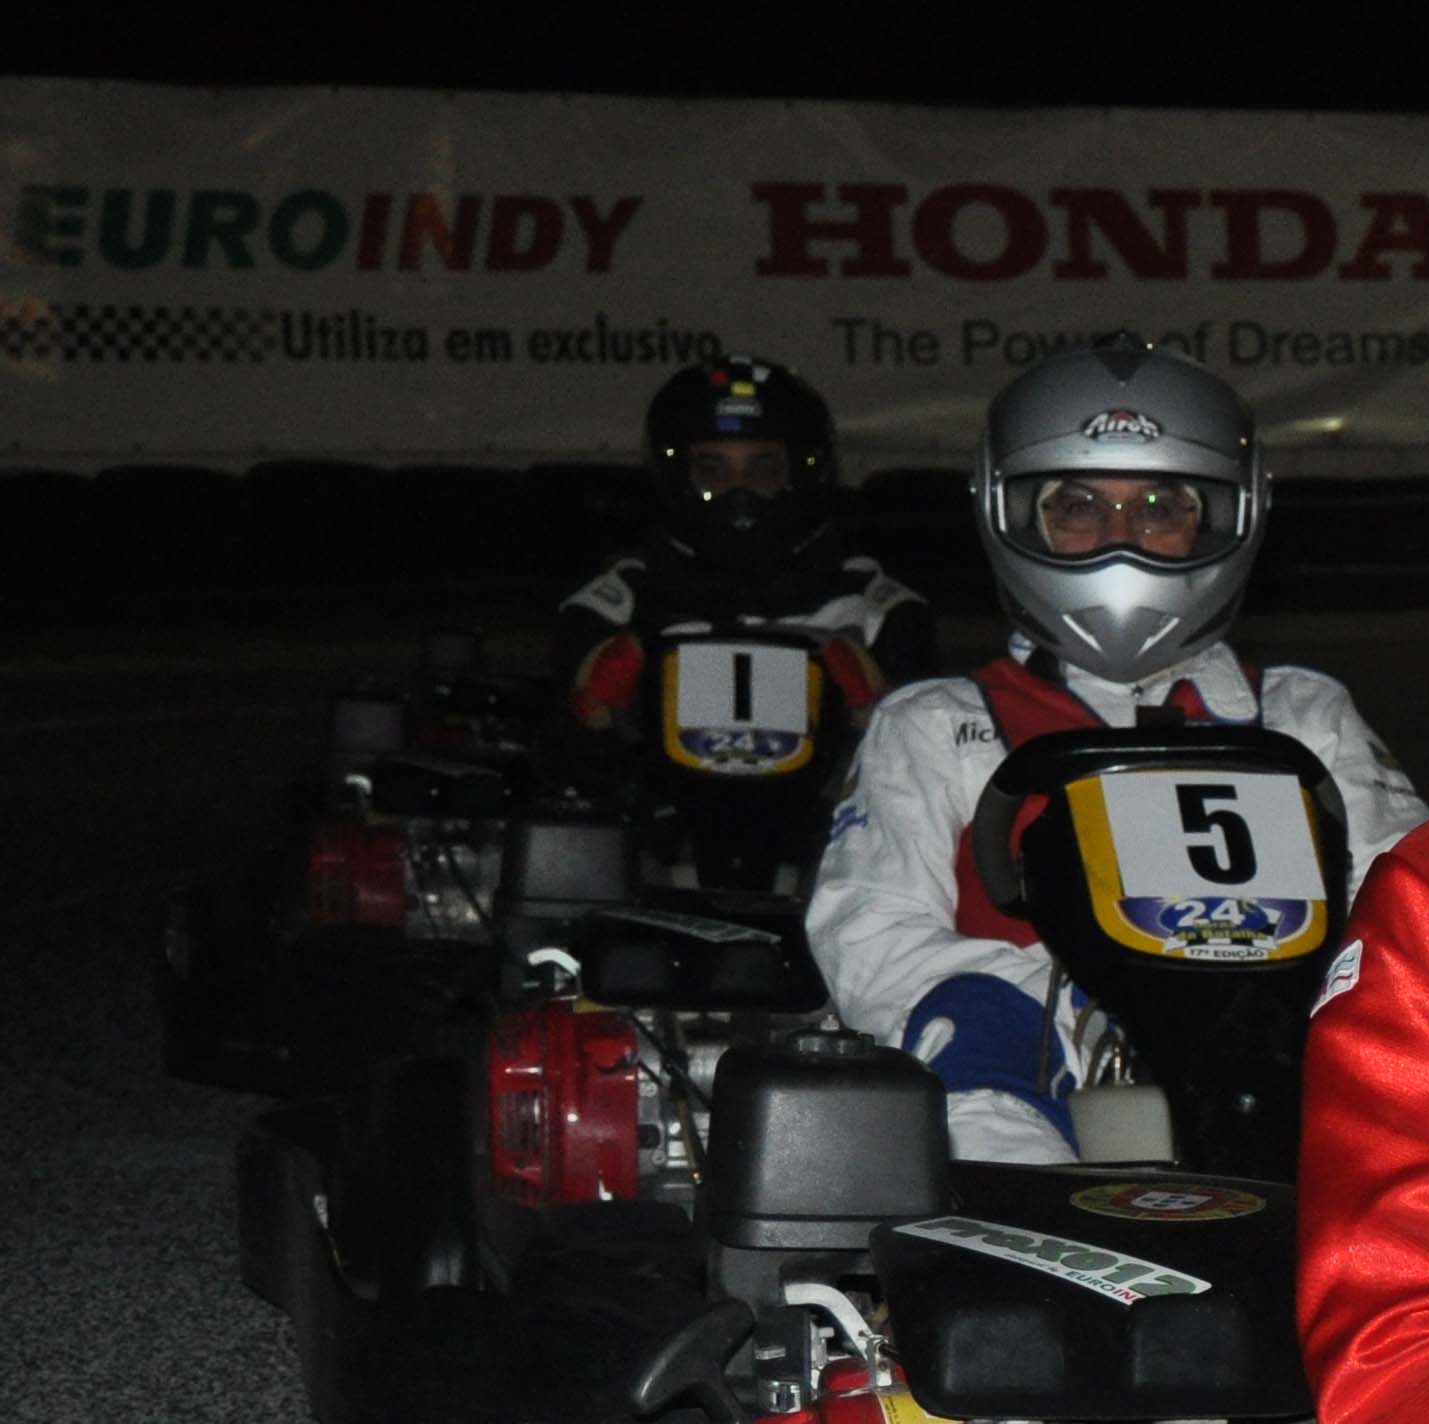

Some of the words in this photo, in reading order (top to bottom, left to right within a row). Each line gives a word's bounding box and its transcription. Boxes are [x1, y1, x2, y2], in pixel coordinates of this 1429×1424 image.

[14, 184, 642, 275] EUROINDY
[280, 311, 429, 364] Utiliza
[445, 329, 511, 364] em
[530, 314, 724, 366] exclusivo
[833, 317, 950, 366] The
[1175, 784, 1258, 885] 5
[1174, 900, 1247, 928] 24
[1213, 946, 1264, 960] EDIÇÃO
